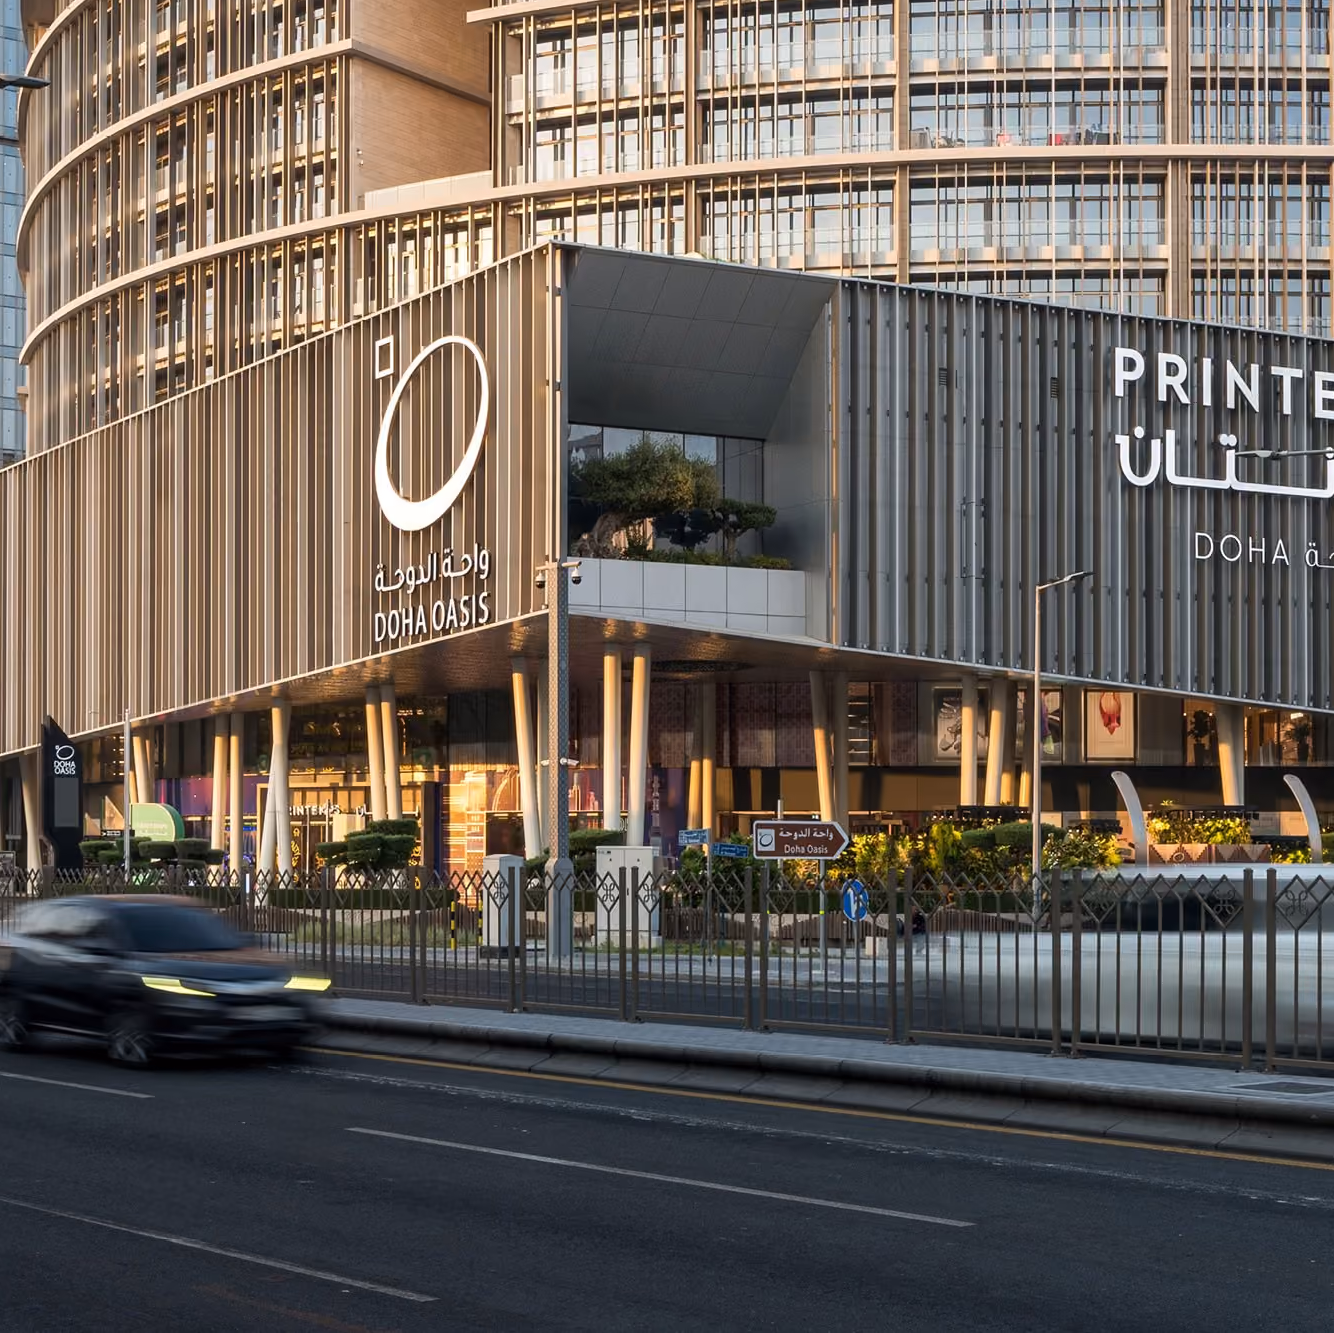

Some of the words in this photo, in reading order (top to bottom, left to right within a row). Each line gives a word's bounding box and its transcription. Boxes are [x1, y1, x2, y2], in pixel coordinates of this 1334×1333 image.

[1194, 532, 1290, 566] DOHA
[442, 543, 491, 580] واحة
[374, 553, 438, 595] الدوحة
[374, 605, 428, 643] DOHA
[432, 591, 491, 632] OASIS
[54, 766, 76, 775] OASIS
[778, 828, 810, 840] الدوحة
[813, 828, 834, 840] واحة
[784, 844, 805, 854] Doha
[807, 844, 828, 854] Oasis
